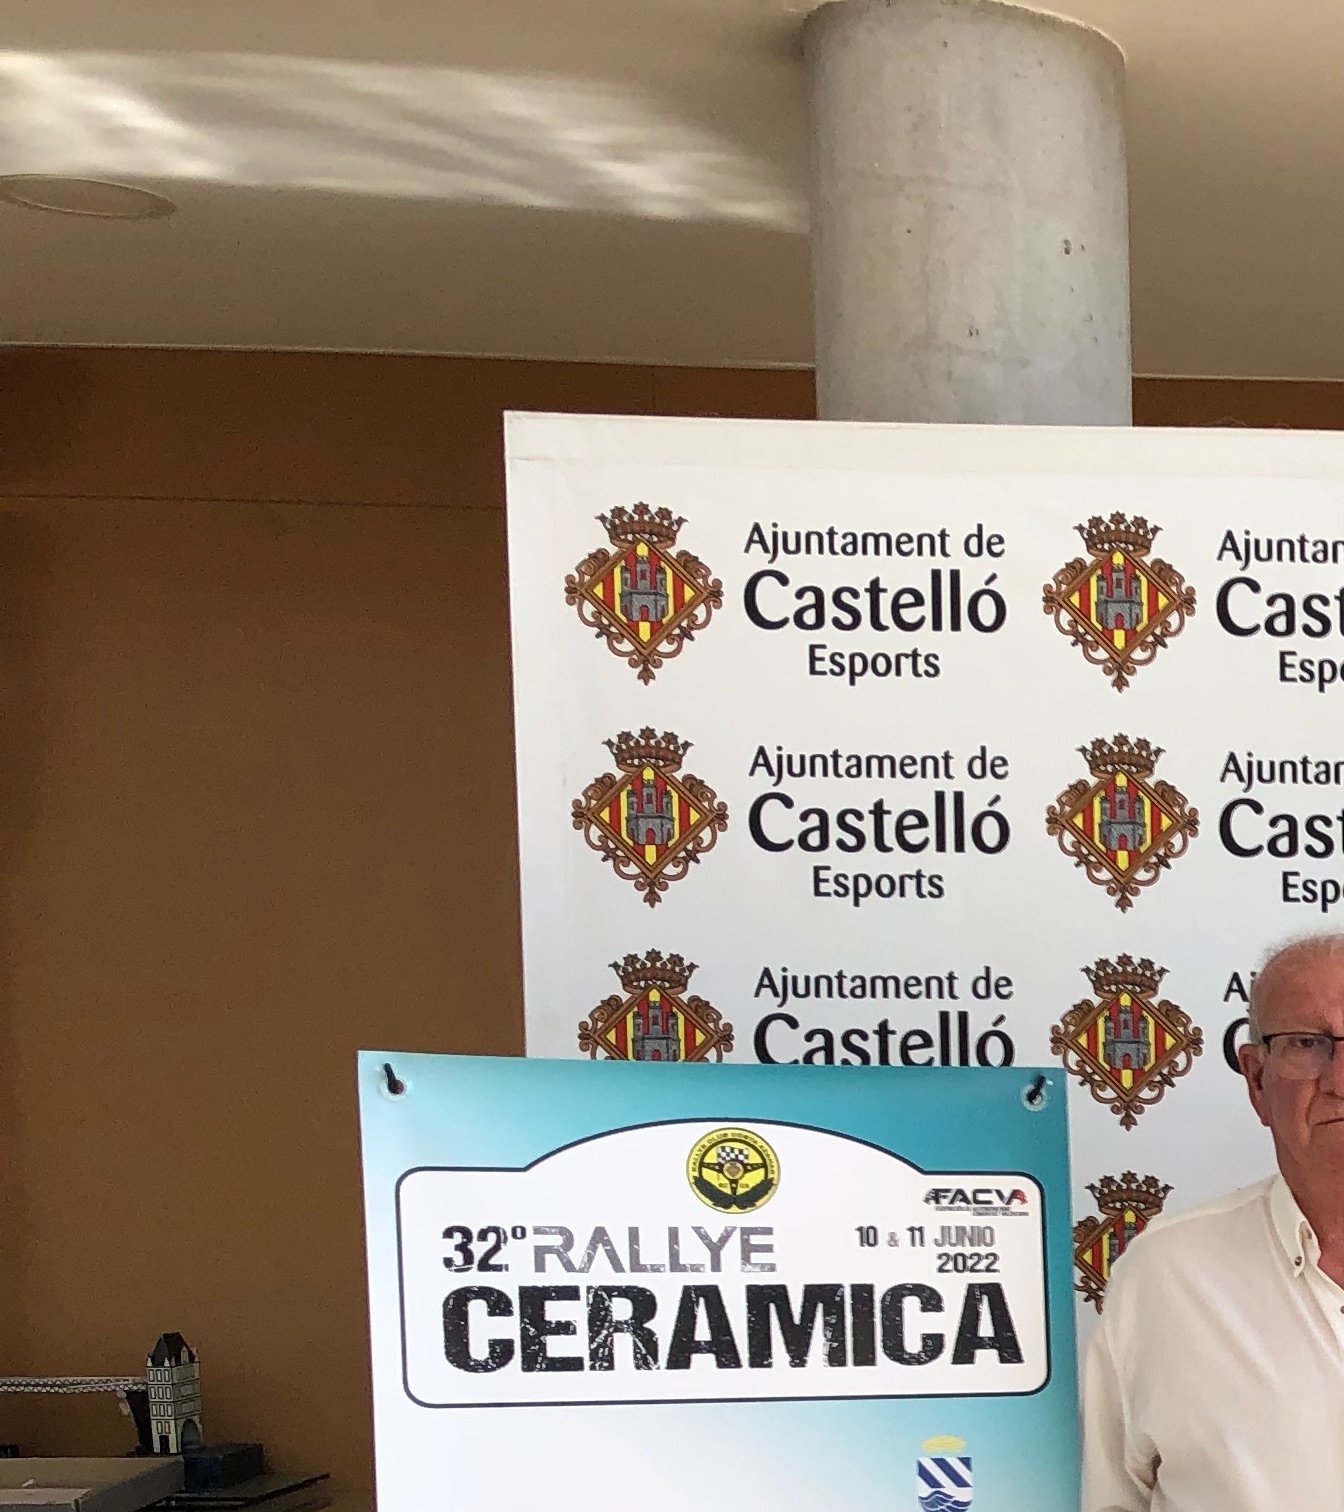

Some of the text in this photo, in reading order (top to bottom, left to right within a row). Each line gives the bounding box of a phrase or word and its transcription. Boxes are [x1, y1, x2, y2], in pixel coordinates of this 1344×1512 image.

[744, 522, 1005, 564] Ajuntament de
[743, 568, 1007, 633] Castelló
[808, 644, 941, 687] Esports
[748, 745, 1009, 787] Ajuntament de
[748, 790, 1010, 855] Castelló
[813, 865, 945, 908] Esports
[533, 1225, 777, 1274] RALLYE
[855, 1225, 878, 1247] 10
[907, 1225, 925, 1246] 11
[932, 1226, 996, 1247] JUNIO
[936, 1252, 1000, 1274] 2022
[441, 1282, 1025, 1374] CERAMICA
